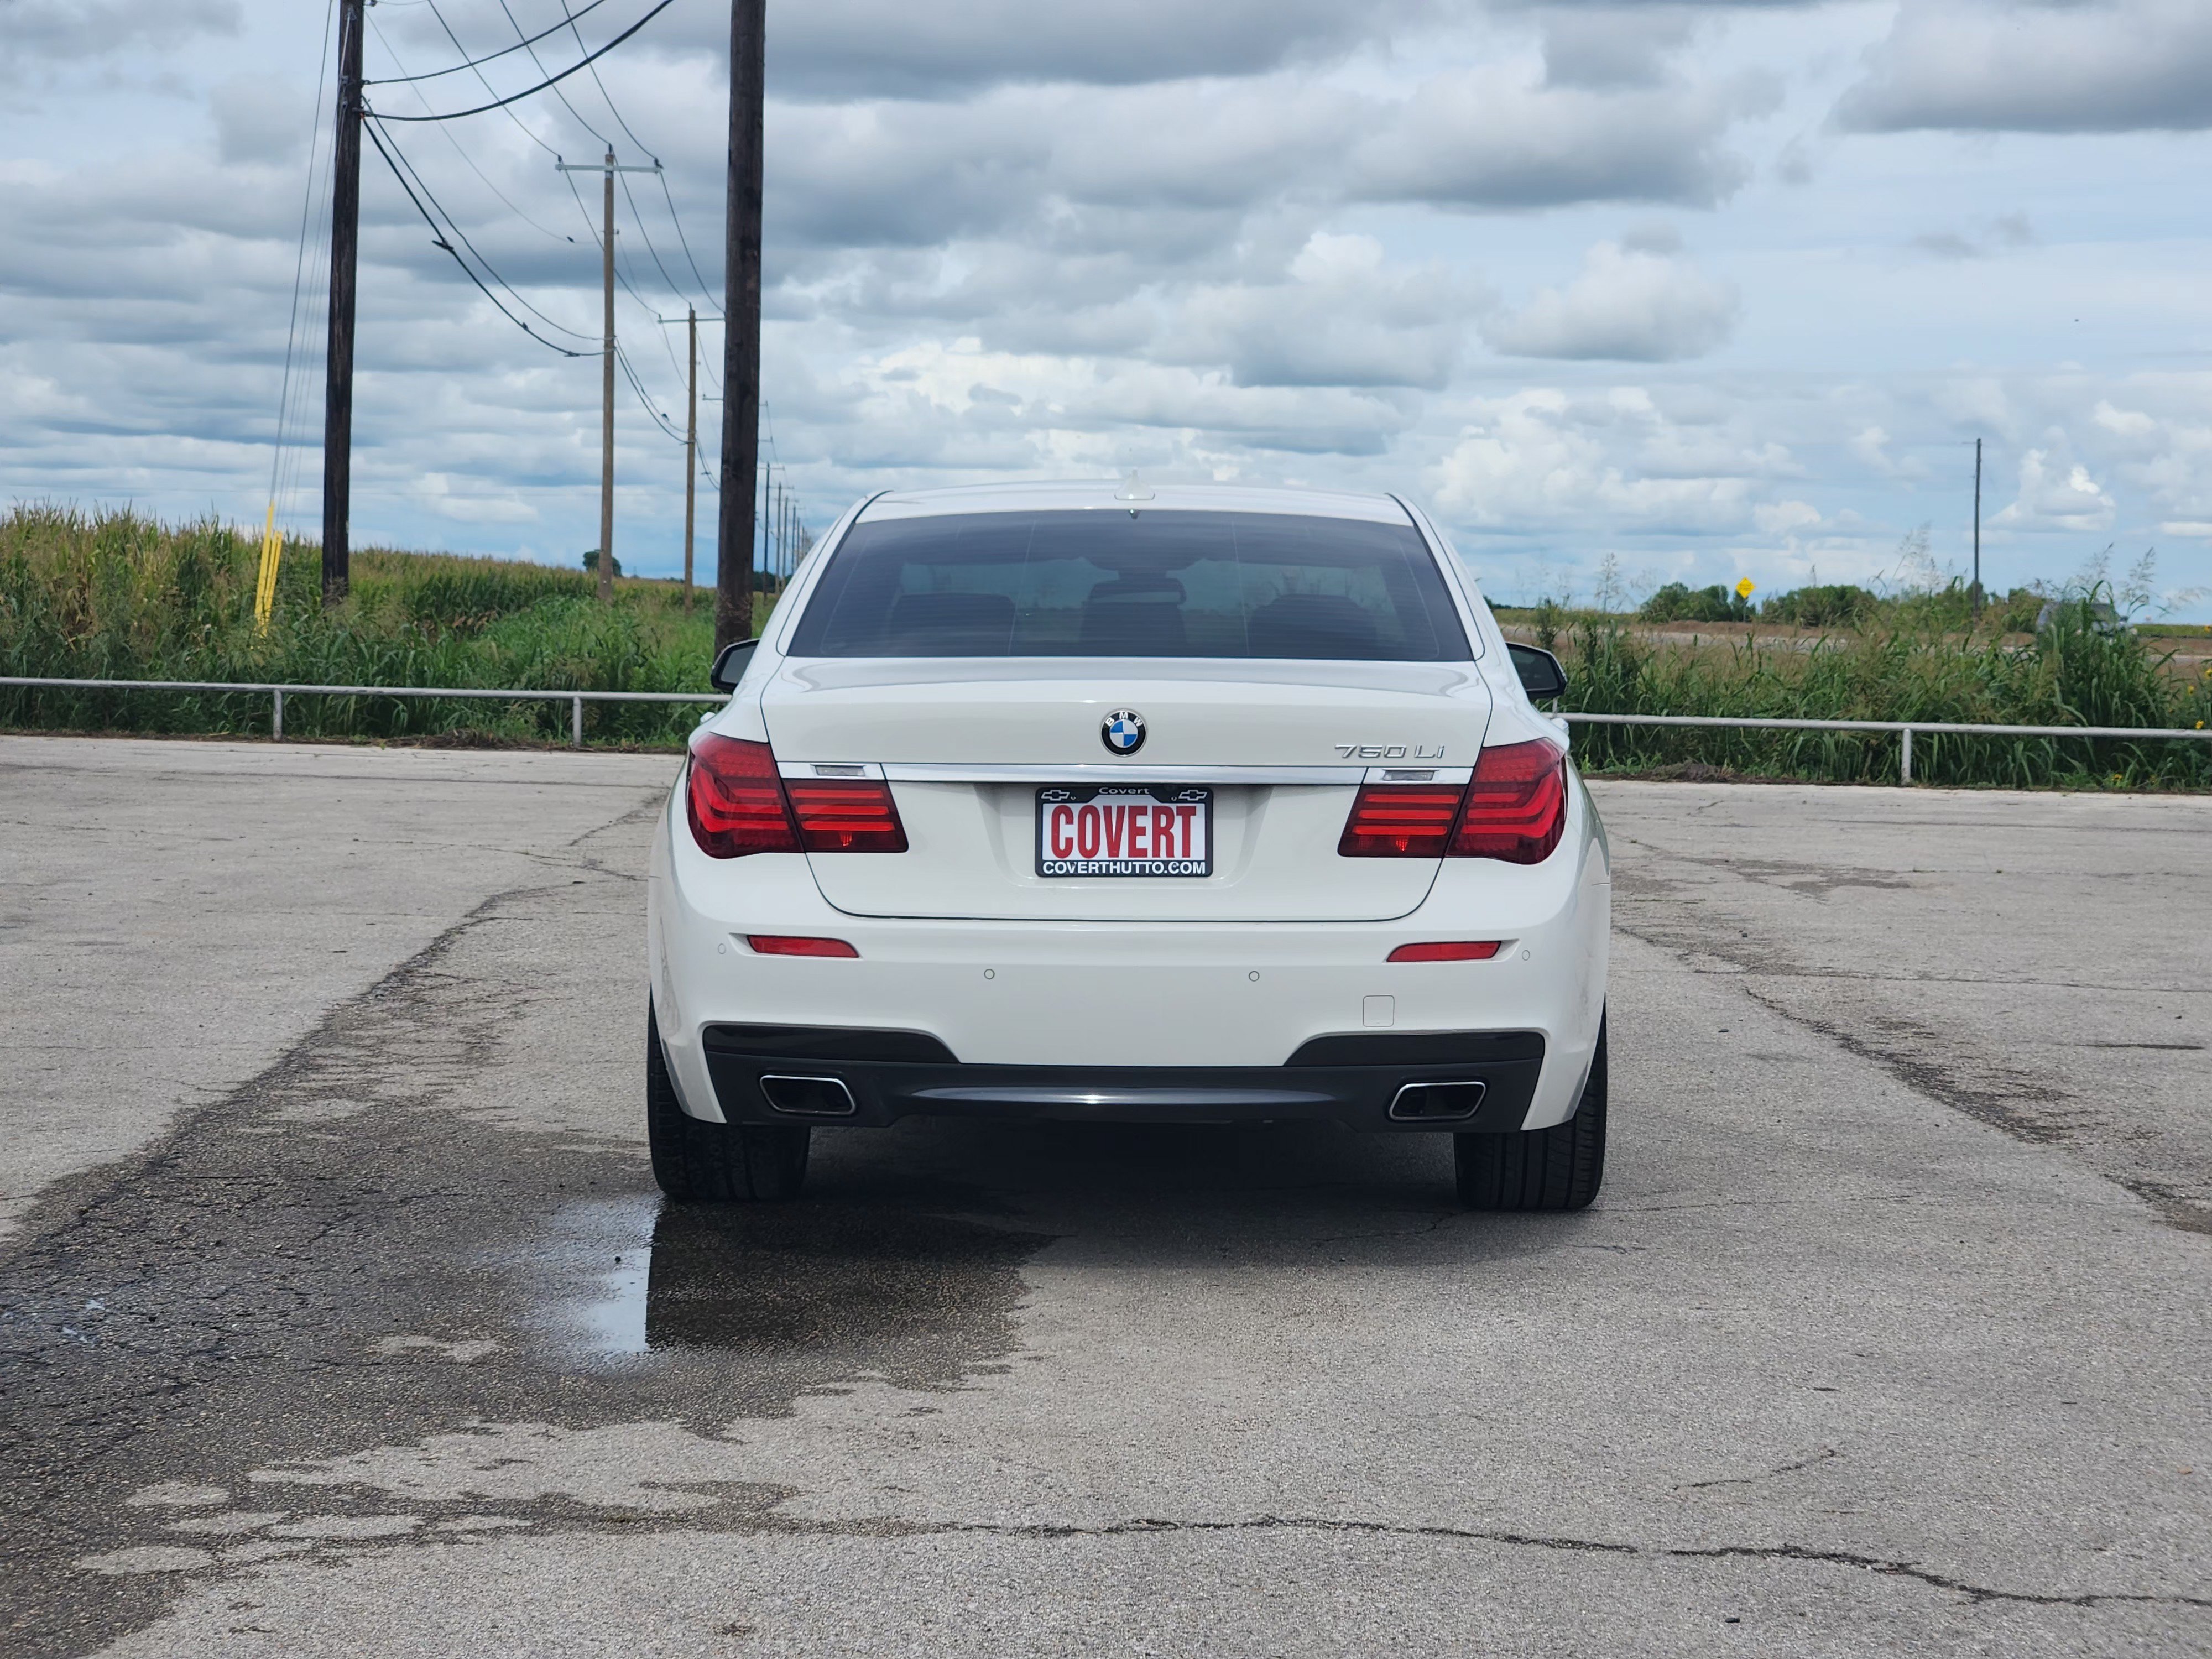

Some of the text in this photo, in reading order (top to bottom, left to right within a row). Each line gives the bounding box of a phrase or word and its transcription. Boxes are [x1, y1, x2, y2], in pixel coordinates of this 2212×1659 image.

[1105, 712, 1143, 727] BMW
[1051, 805, 1197, 859] COVERT
[1042, 861, 1206, 874] COVERTHUTTO.COM
